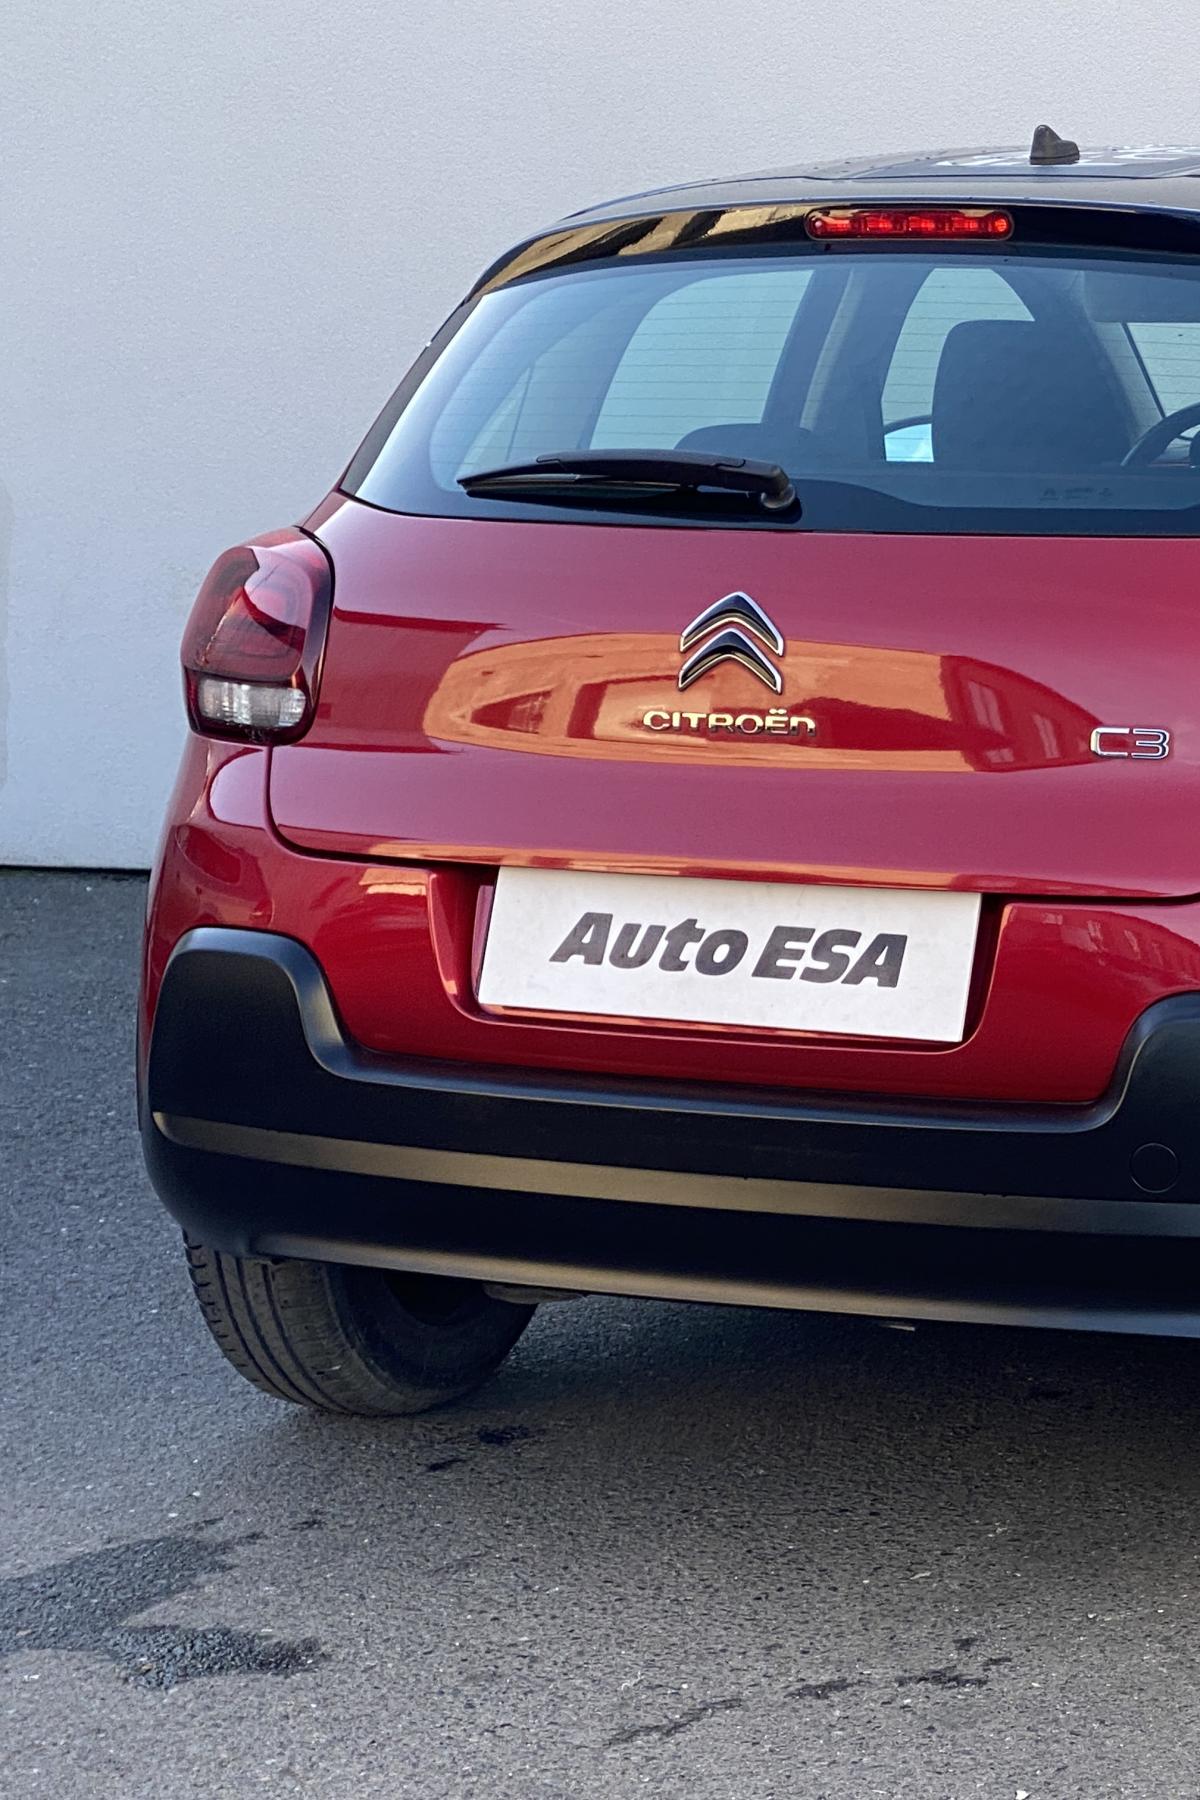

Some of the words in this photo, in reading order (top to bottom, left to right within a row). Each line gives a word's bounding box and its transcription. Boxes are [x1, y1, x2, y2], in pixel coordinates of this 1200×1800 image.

[1090, 727, 1170, 760] C3
[549, 911, 749, 976] Auto
[751, 925, 908, 988] ESA
